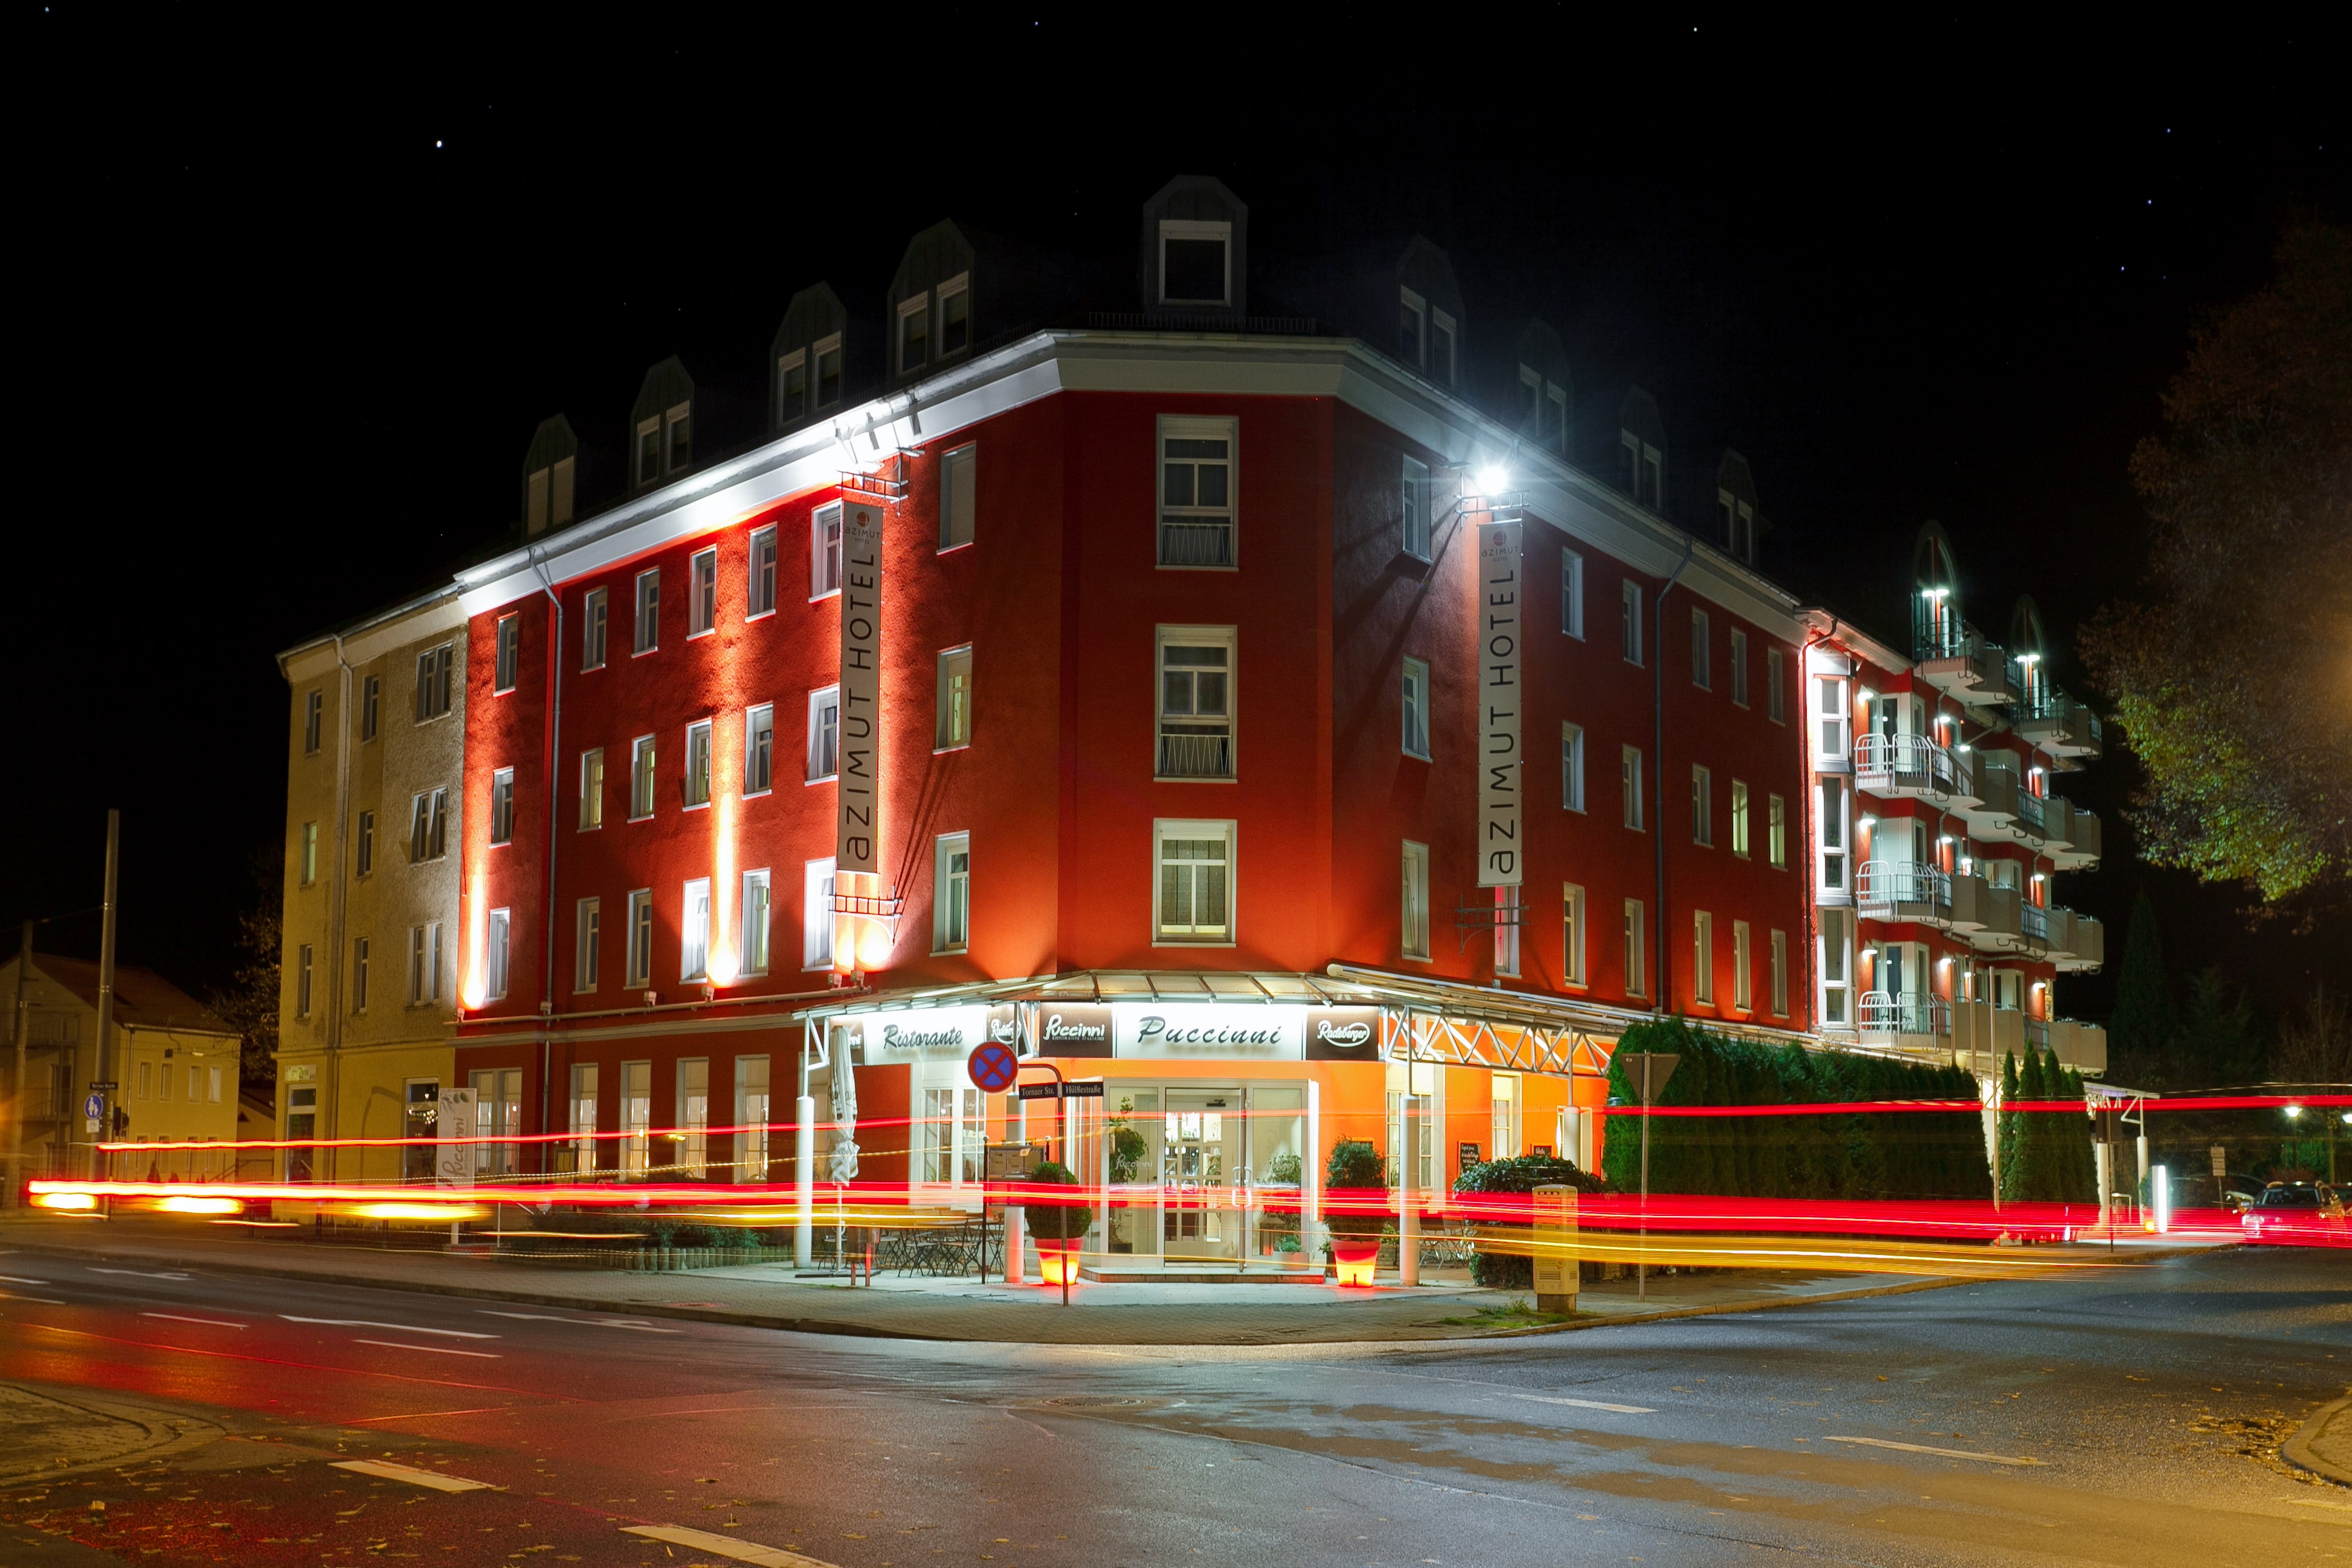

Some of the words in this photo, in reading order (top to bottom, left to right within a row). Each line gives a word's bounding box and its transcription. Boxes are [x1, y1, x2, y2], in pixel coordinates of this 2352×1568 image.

[849, 554, 874, 669] HOTEL
[1489, 570, 1514, 686] HOTEL
[884, 1024, 962, 1049] Ristorante
[1043, 1014, 1105, 1040] Puccinni
[1138, 1016, 1282, 1044] Puccinni
[1317, 1020, 1370, 1047] Radeberger
[1021, 1087, 1043, 1097] Tornaer
[1044, 1086, 1054, 1095] Str.
[1066, 1085, 1101, 1093] Hülßestraße
